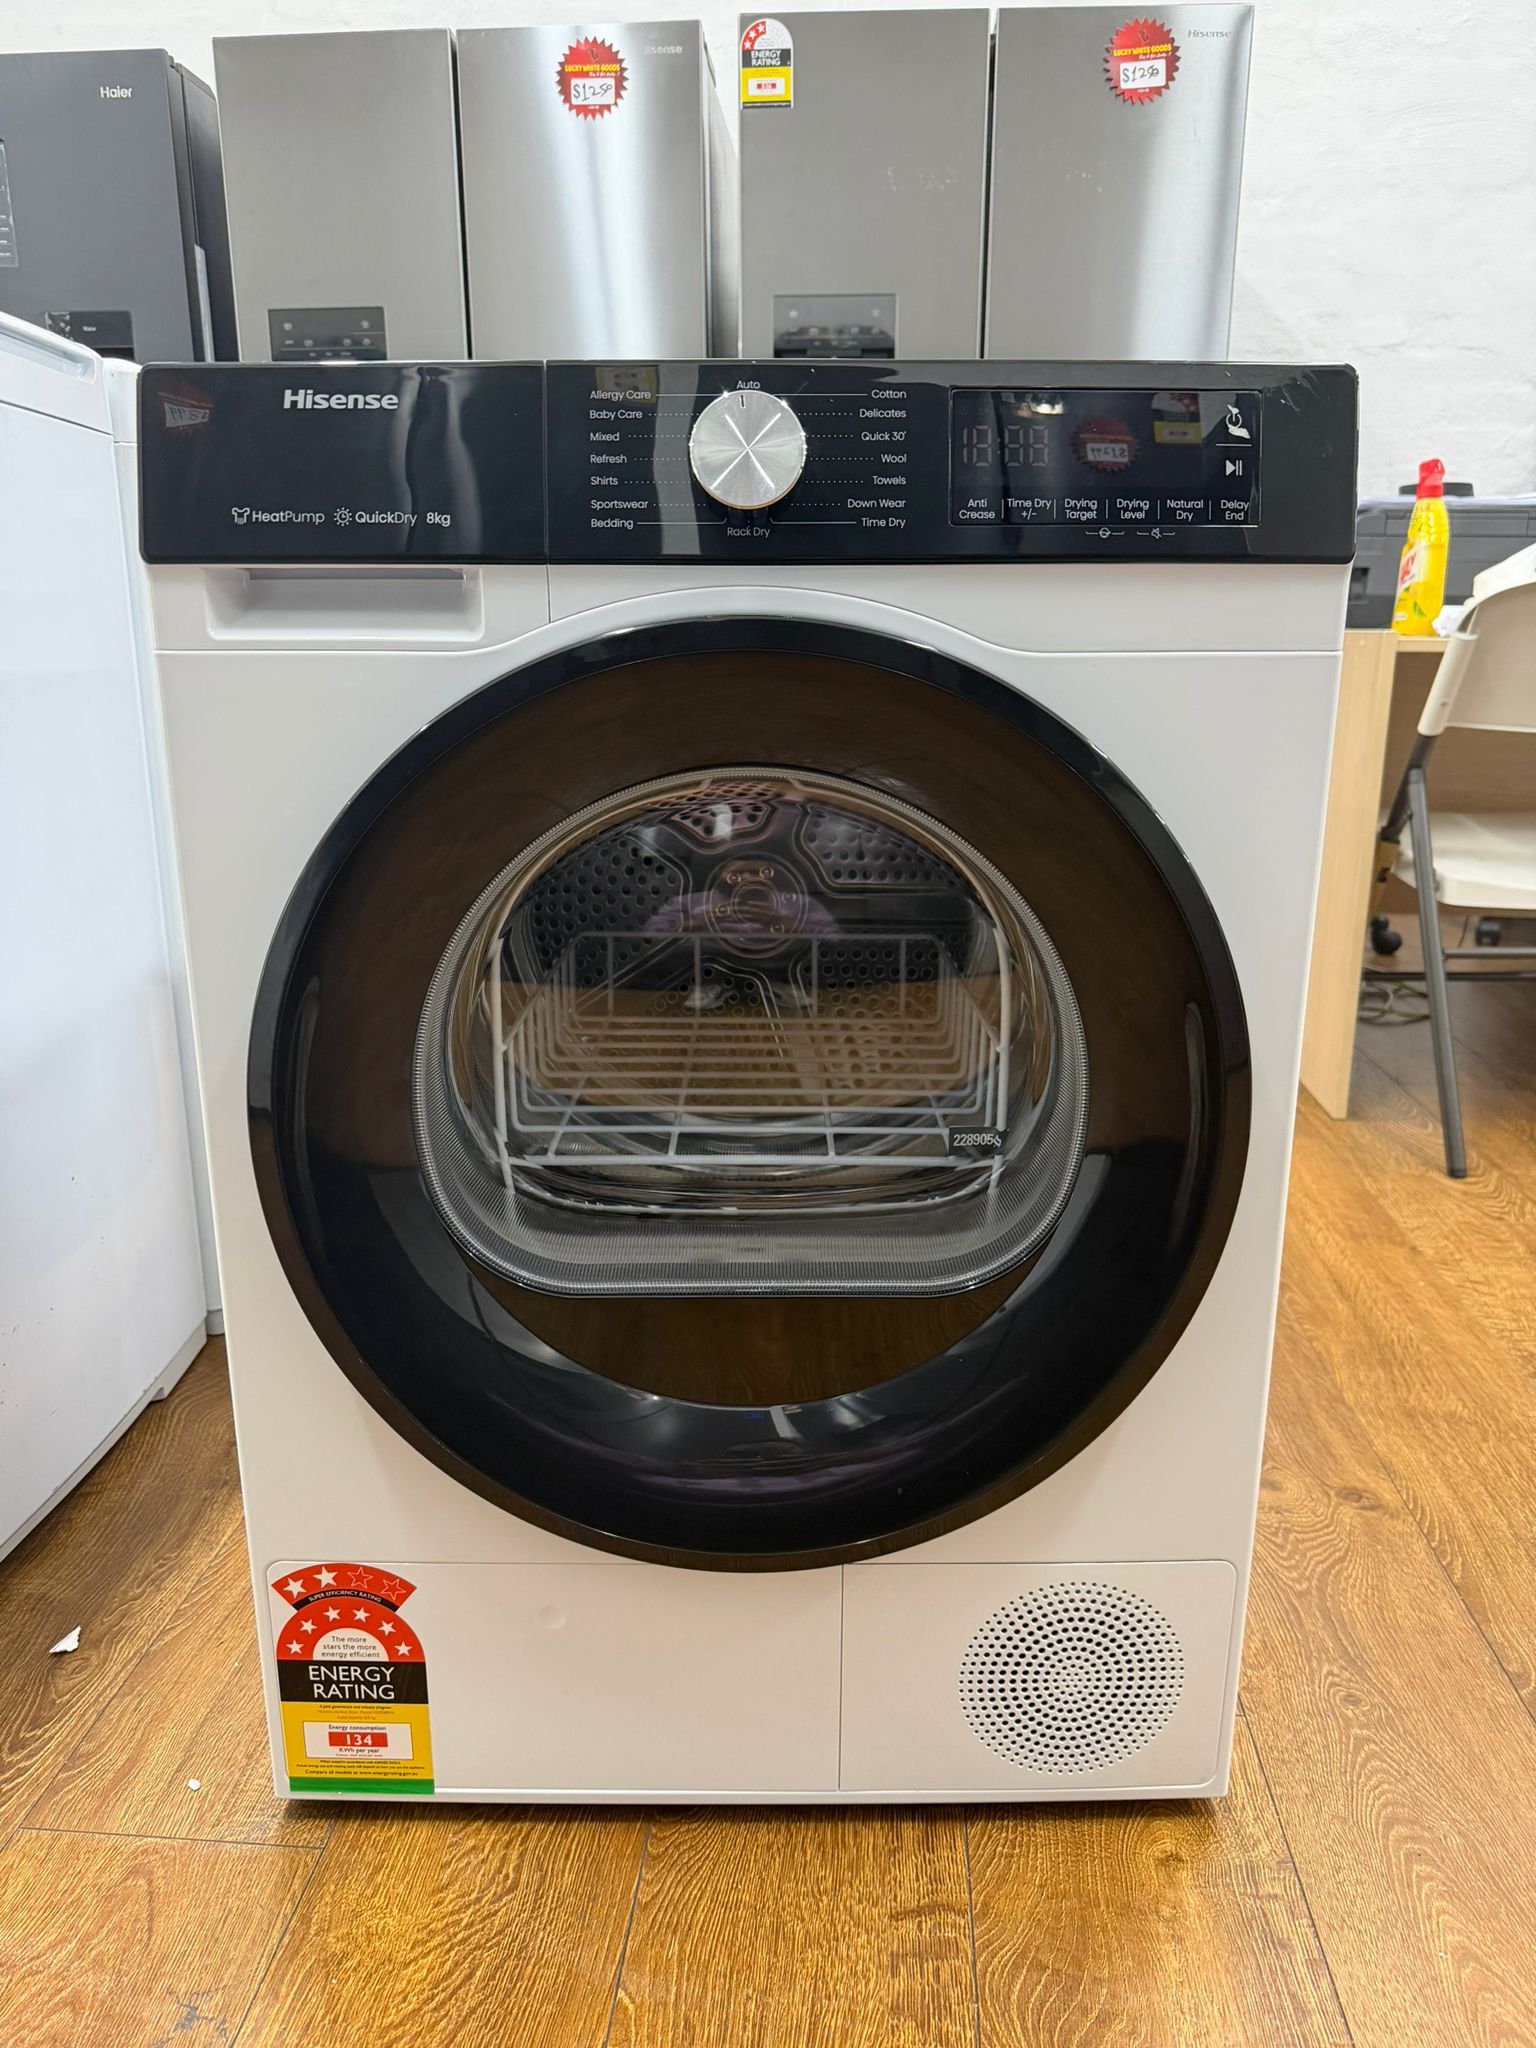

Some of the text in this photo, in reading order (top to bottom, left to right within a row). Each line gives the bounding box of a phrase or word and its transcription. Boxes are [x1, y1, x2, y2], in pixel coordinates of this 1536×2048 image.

[1187, 29, 1232, 38] Hisense
[1151, 44, 1172, 53] GOODS
[751, 50, 781, 58] ENERGY
[752, 58, 780, 66] RATING
[100, 86, 132, 98] Haier
[737, 380, 760, 390] Auto
[590, 389, 651, 401] Allergy Care
[871, 389, 907, 399] Cotton
[283, 389, 399, 410] Hisense
[589, 409, 643, 421] Baby Care
[859, 408, 907, 418] Delicates
[590, 431, 620, 441] Mixed
[861, 431, 889, 441] Quick
[590, 454, 627, 464] Refresh
[881, 454, 907, 463] Wool
[591, 476, 618, 486] Shirts
[872, 475, 907, 485] Towels
[591, 499, 649, 511] Sportswear
[847, 498, 906, 508] Down Wear
[968, 498, 988, 508] Anti
[1007, 498, 1052, 510] Time Dry
[1064, 498, 1097, 510] Drying
[1116, 498, 1149, 510] Drying
[1167, 499, 1203, 509] Natural
[1220, 499, 1249, 510] Delay
[252, 510, 325, 525] HeatPump
[355, 511, 451, 527] QuickDry 8kg
[959, 509, 995, 519] Crease
[1021, 509, 1037, 519] +/-
[1064, 509, 1097, 521] Target
[1120, 509, 1146, 519] Level
[1176, 510, 1193, 522] Dry
[1225, 510, 1244, 520] End
[591, 518, 634, 530] Bedding
[861, 518, 906, 529] Time Dry
[727, 526, 771, 538] Rack Dry
[309, 1593, 325, 1602] SUPER
[359, 1592, 381, 1602] RATING
[309, 1666, 395, 1681] ENERGY
[314, 1685, 395, 1699] RATING
[346, 1734, 372, 1745] 134
